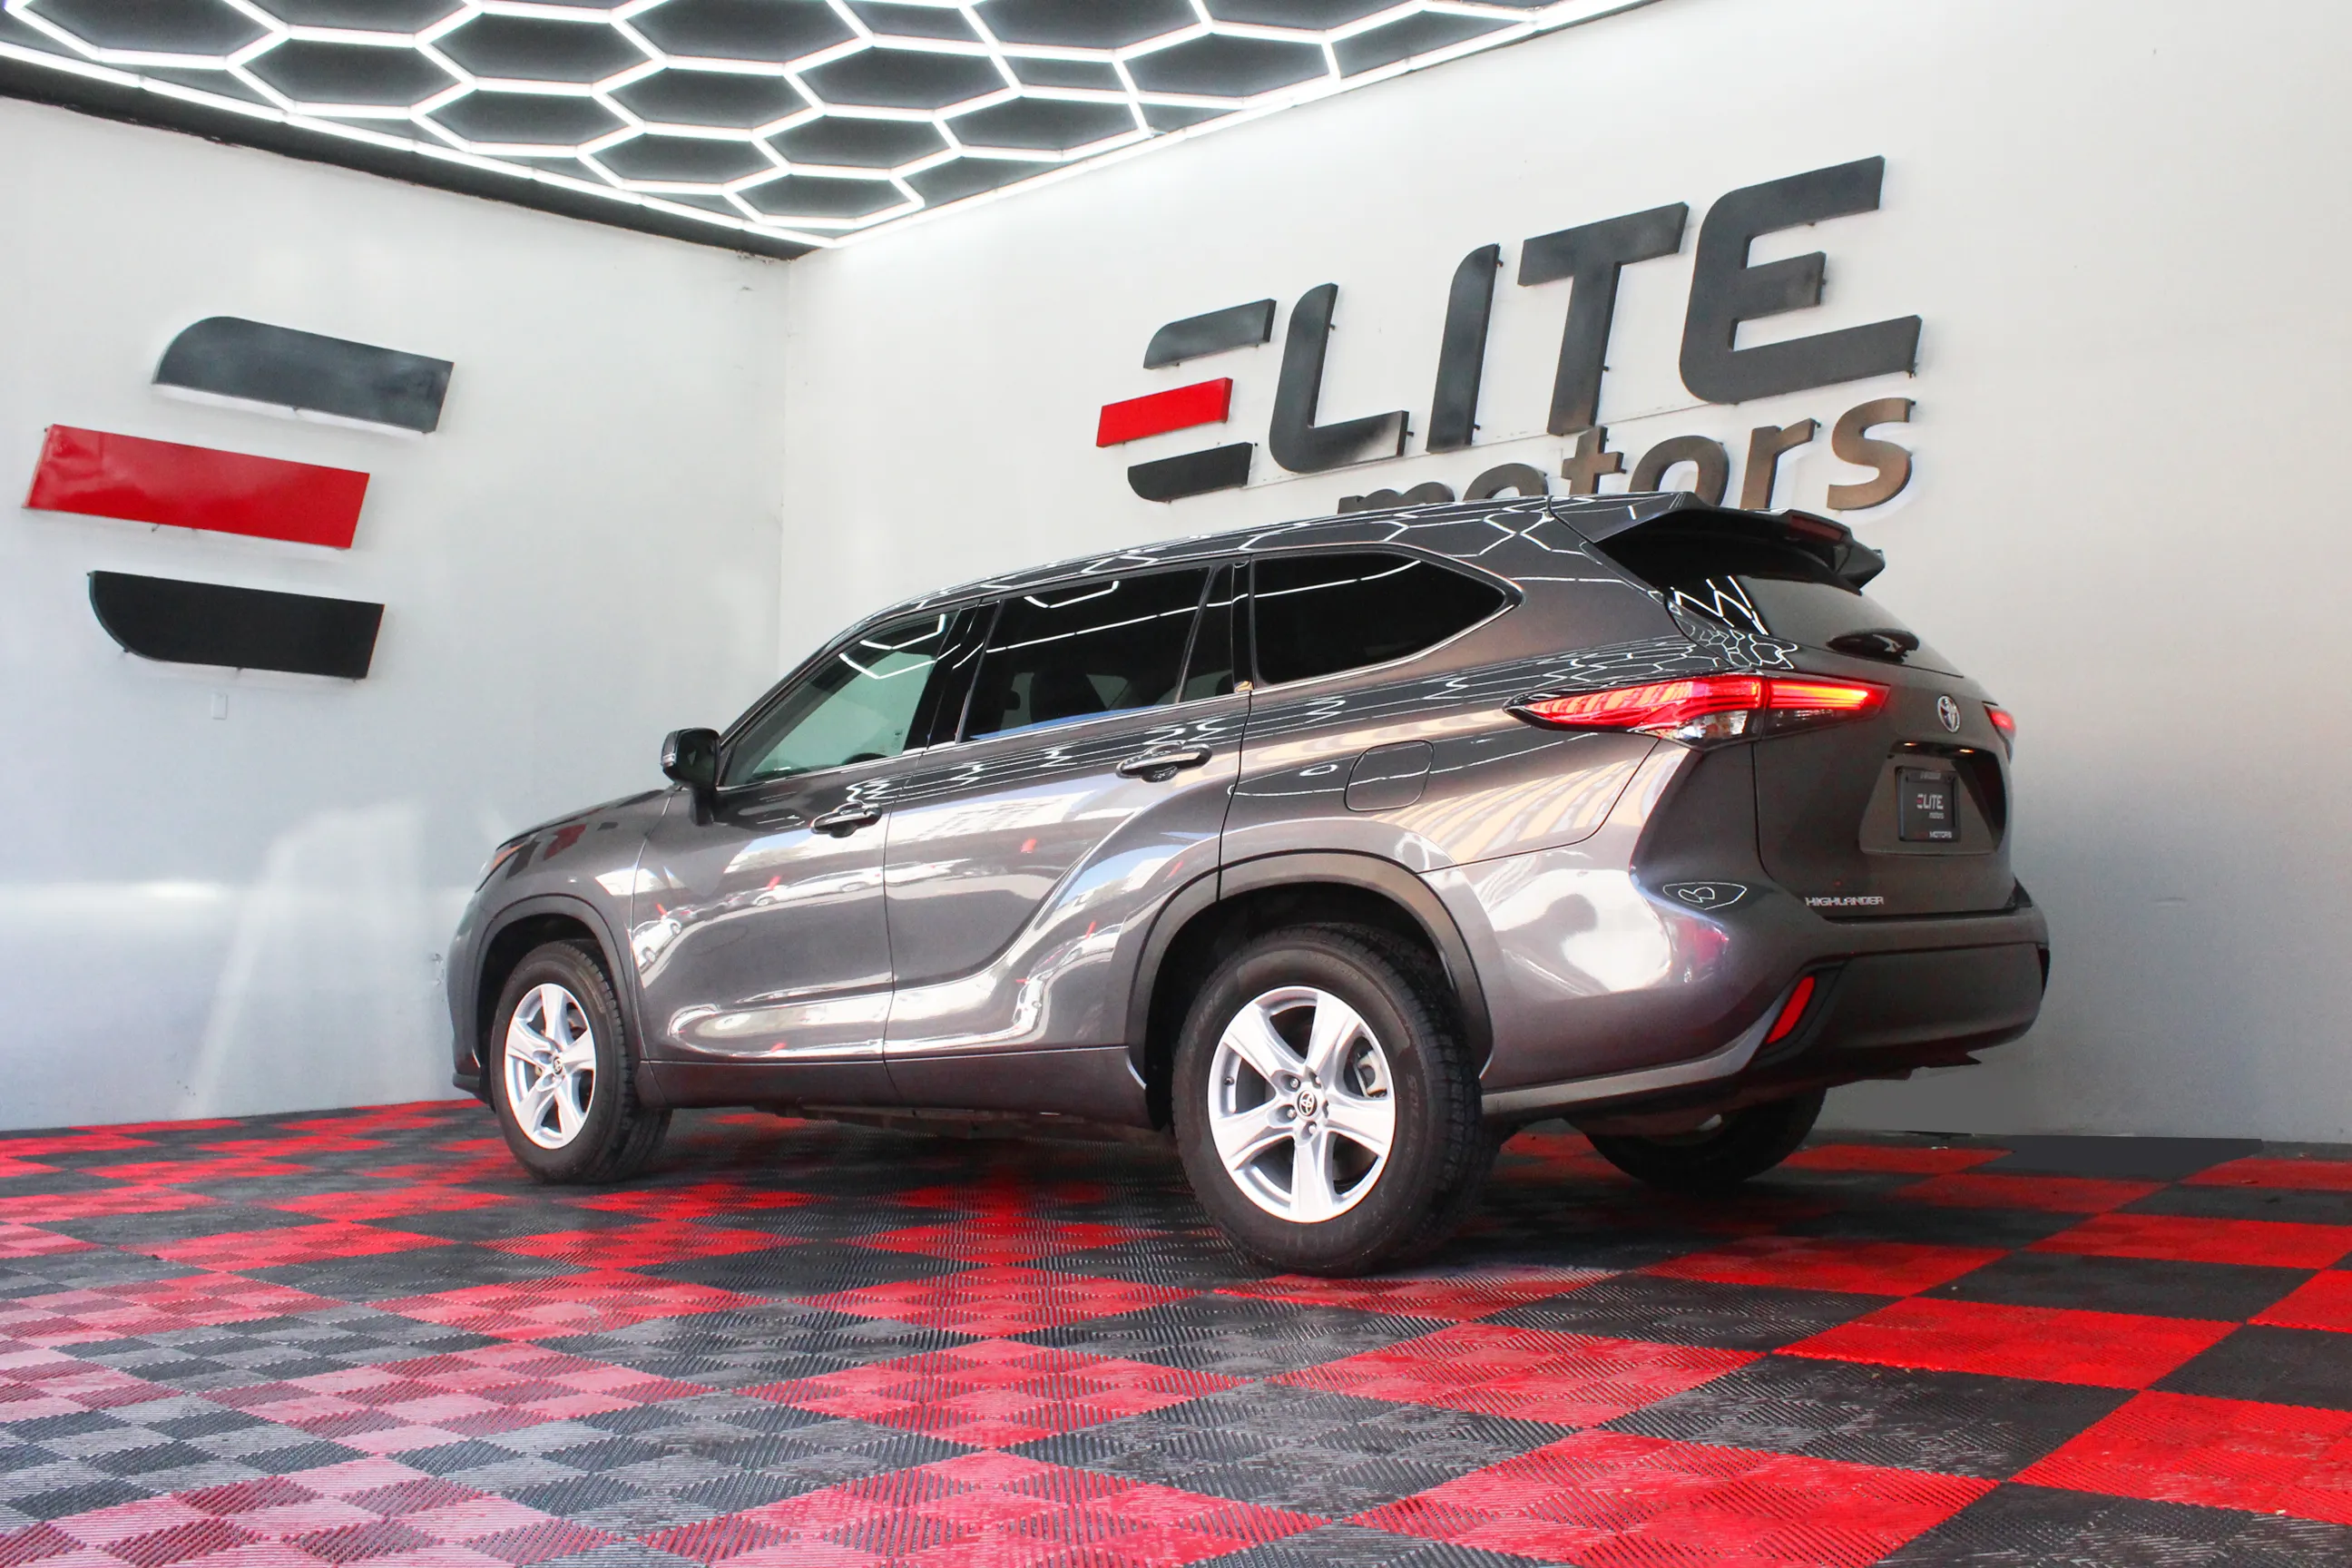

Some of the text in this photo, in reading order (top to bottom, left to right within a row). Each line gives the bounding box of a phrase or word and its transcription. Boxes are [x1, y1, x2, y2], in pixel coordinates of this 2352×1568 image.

[1095, 154, 1923, 504] ELITE
[1338, 397, 1916, 514] tors
[1916, 792, 1944, 809] ELITE
[1804, 896, 1885, 906] HIGHLANDER
